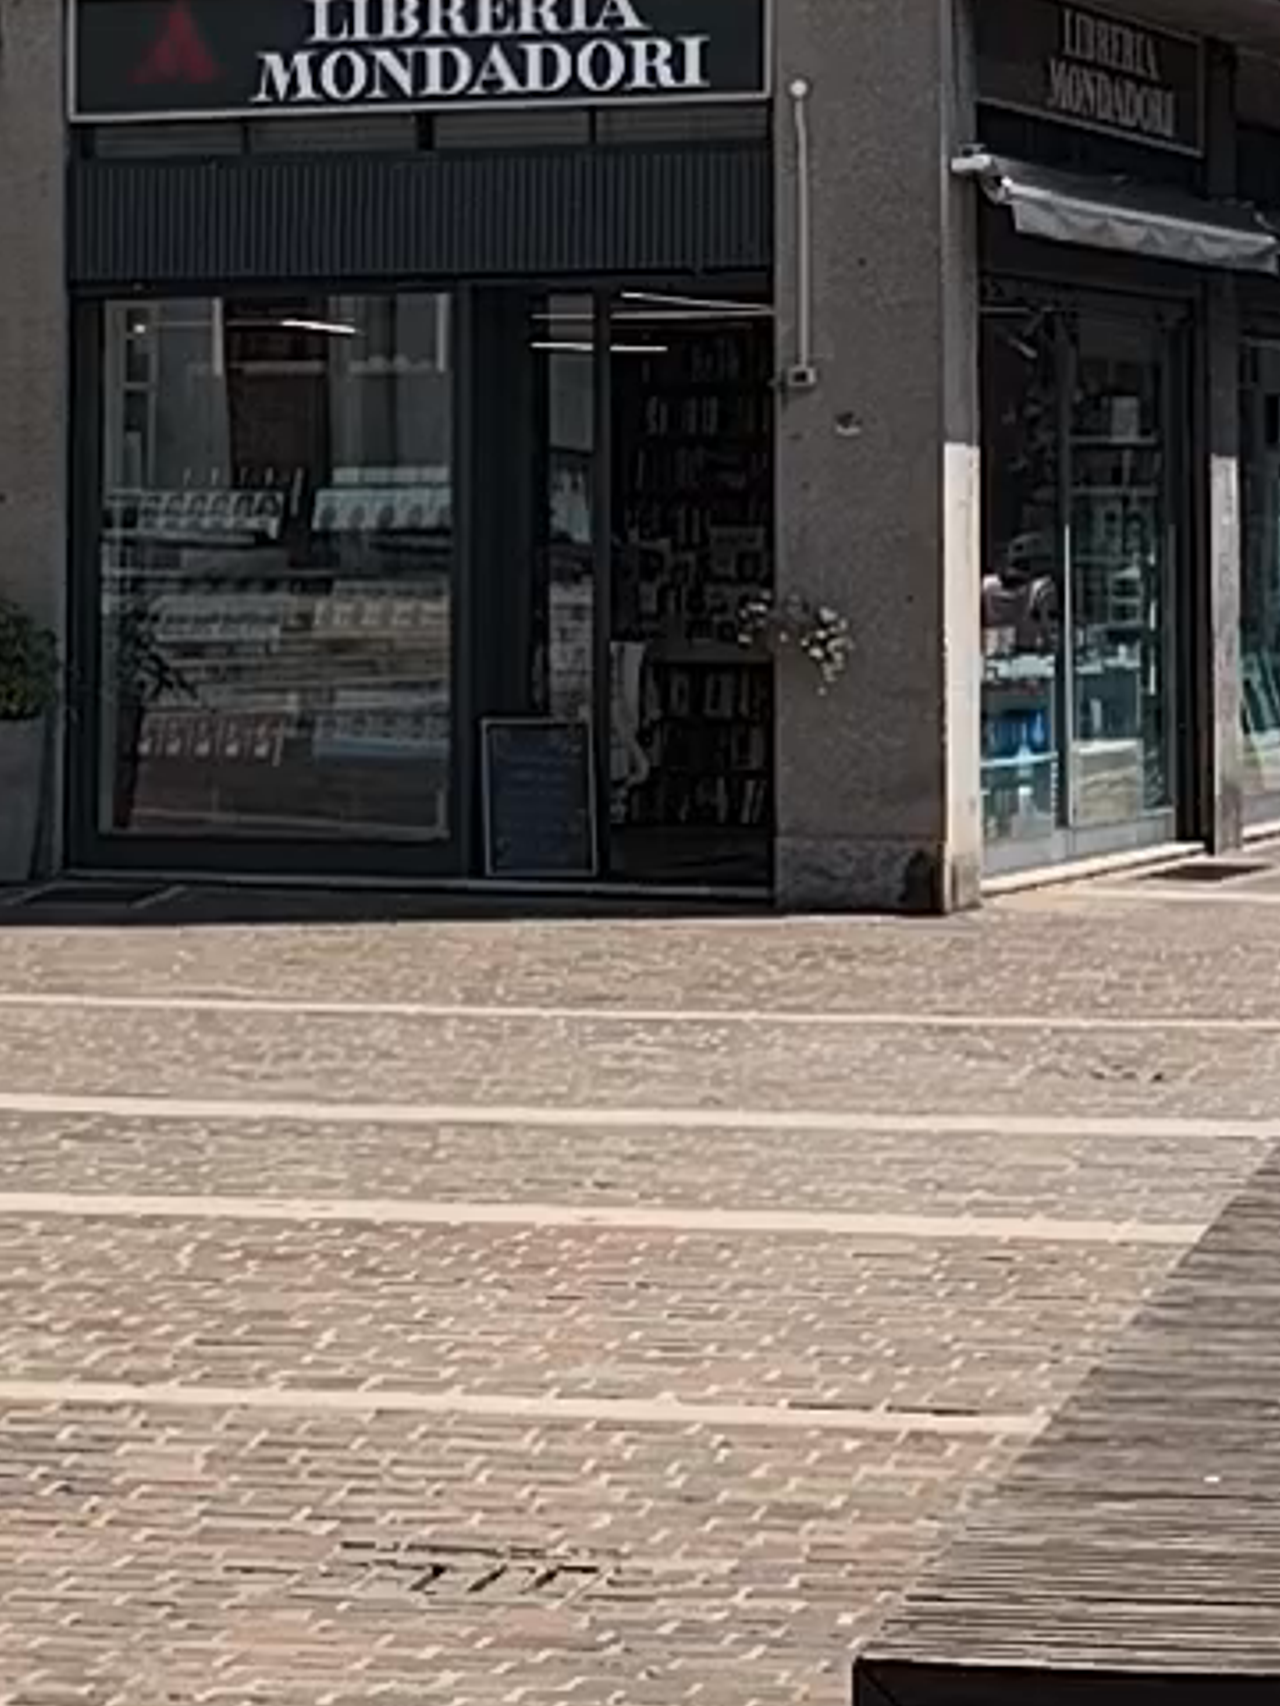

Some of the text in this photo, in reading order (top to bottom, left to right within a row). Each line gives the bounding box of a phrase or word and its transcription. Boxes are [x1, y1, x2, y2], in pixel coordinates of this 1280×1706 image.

[250, 35, 710, 102] MONDADORI
[1063, 7, 1161, 82] LIBRERIA
[1047, 57, 1173, 137] MONDADORI
